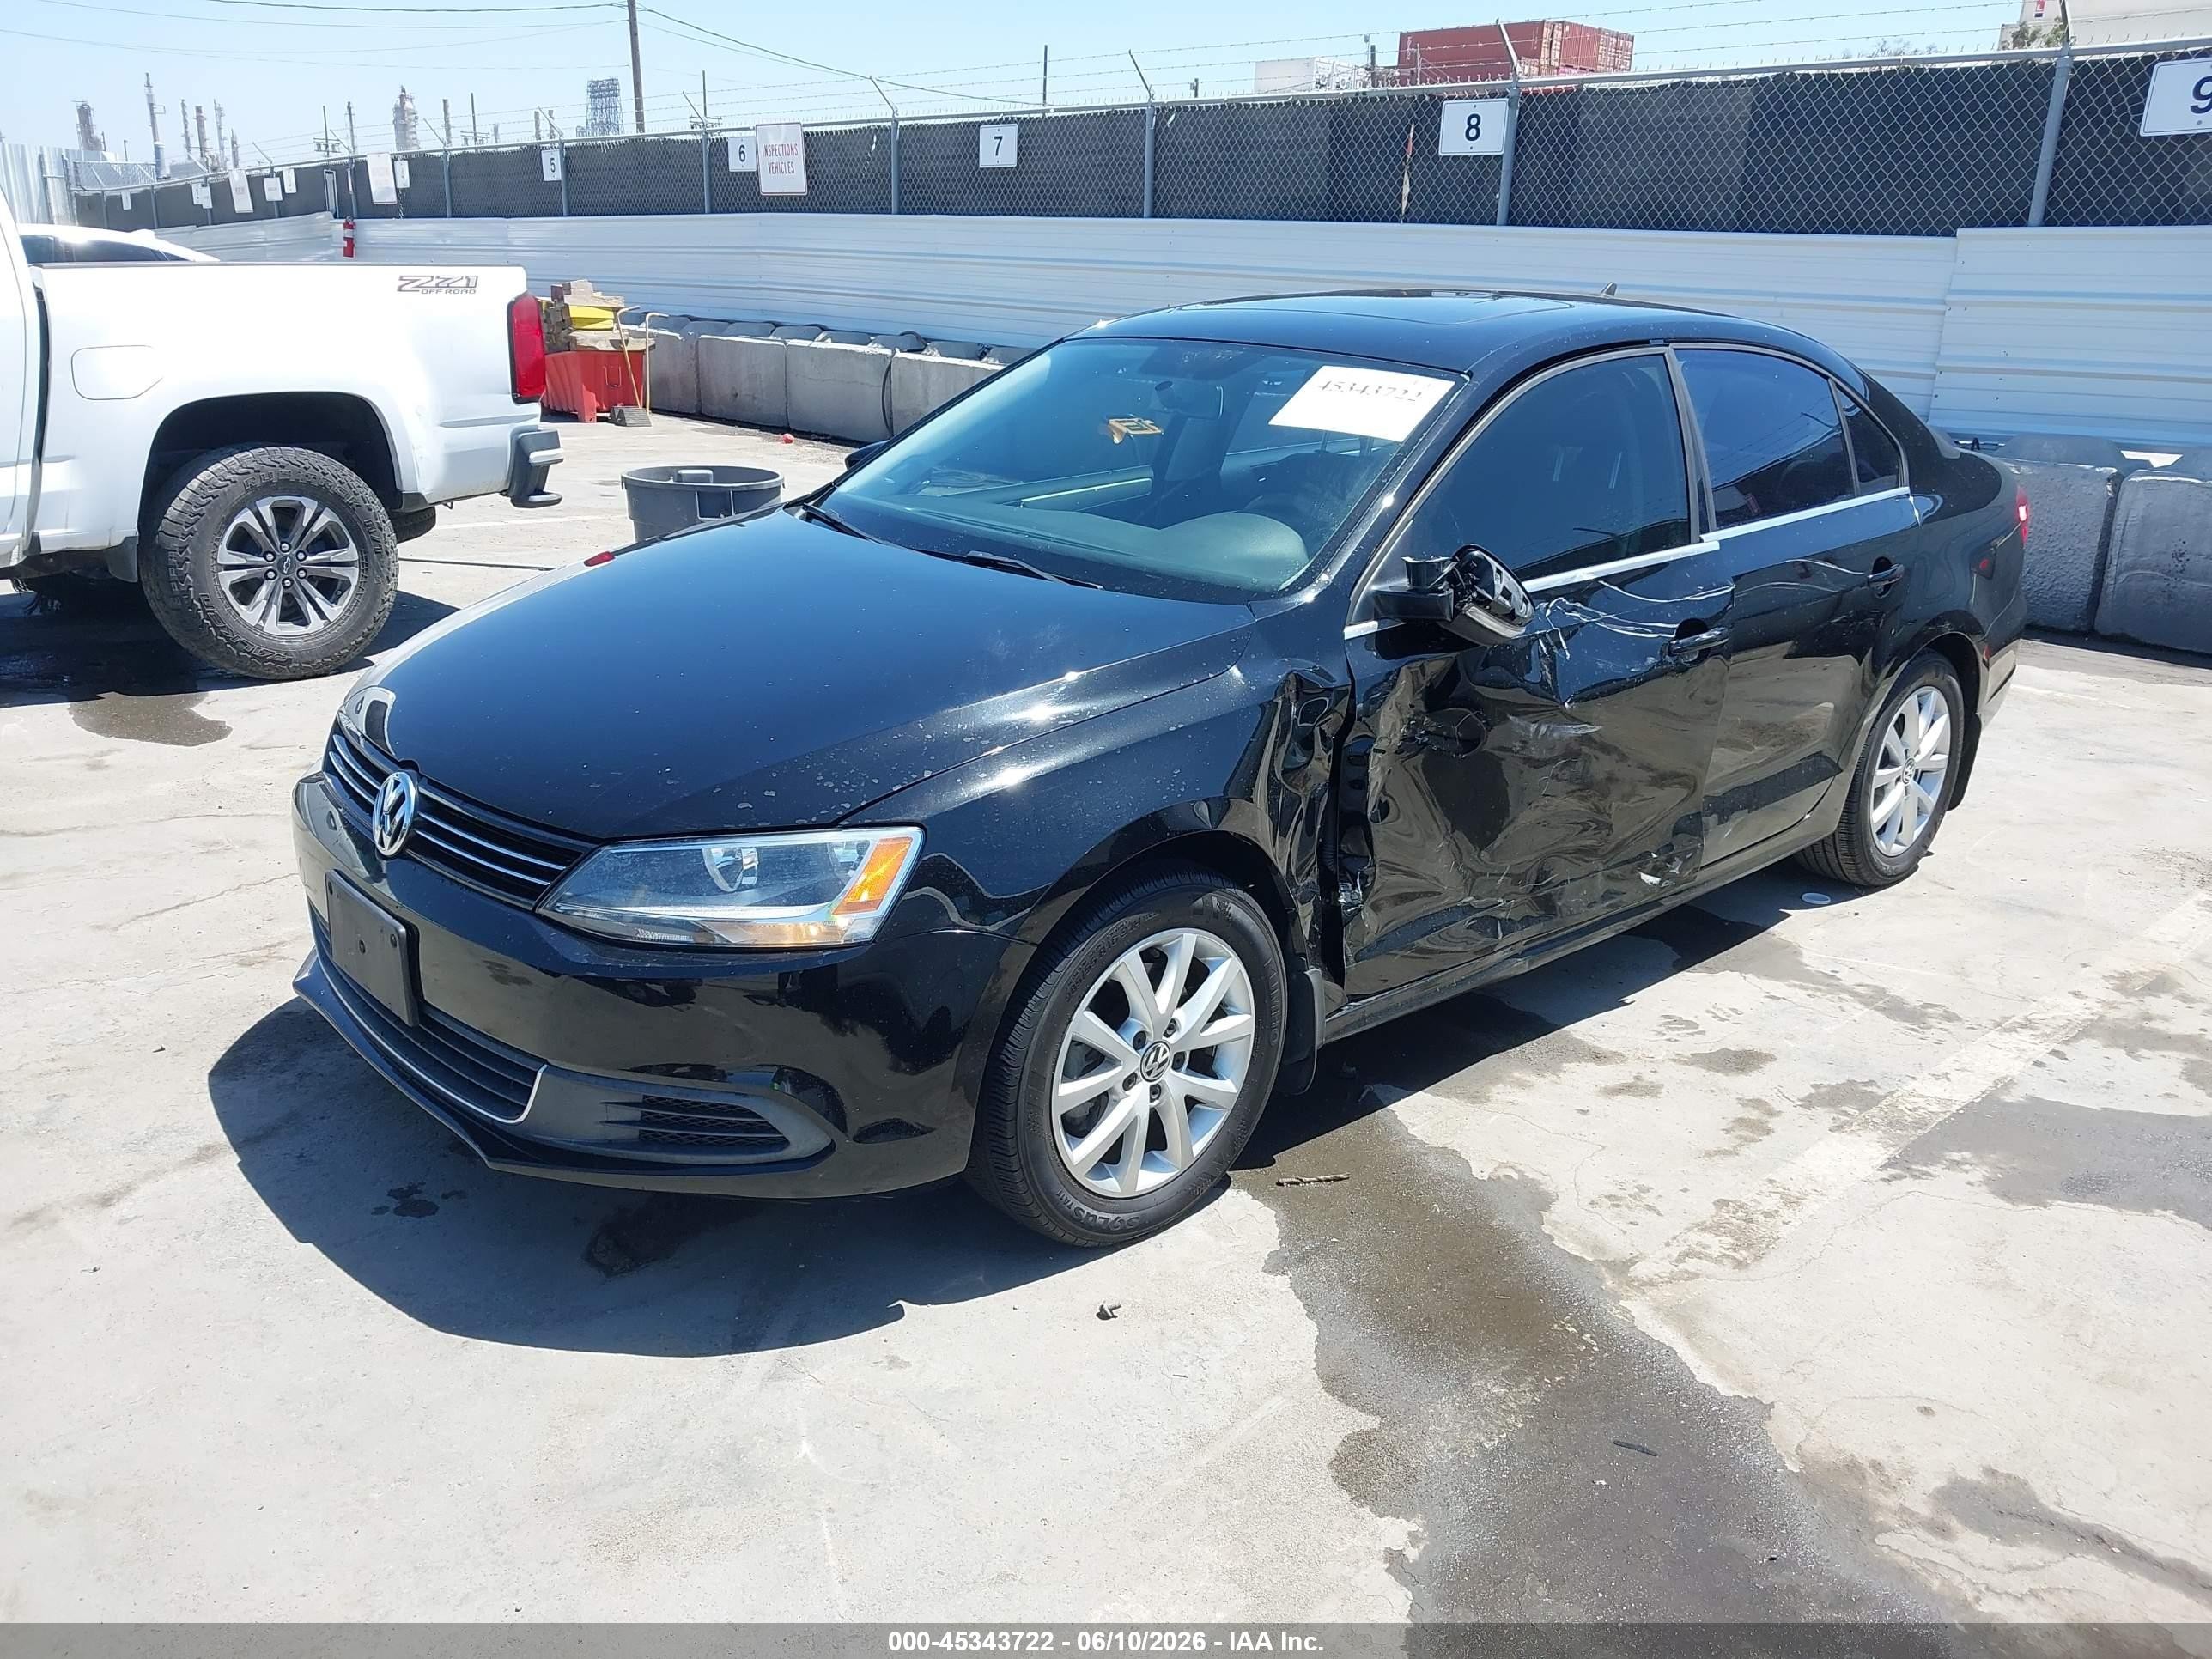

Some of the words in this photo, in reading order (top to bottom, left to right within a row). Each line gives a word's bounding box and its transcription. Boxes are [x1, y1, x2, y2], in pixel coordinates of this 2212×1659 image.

[2190, 76, 2212, 114] 9
[1465, 113, 1481, 141] 8
[738, 144, 746, 162] 6
[763, 143, 799, 157] INSPECTIONS
[994, 136, 1003, 156] 7
[550, 157, 556, 173] 5
[768, 161, 795, 174] VEHICLES
[397, 275, 478, 292] Z71
[198, 592, 293, 662] FALKEN
